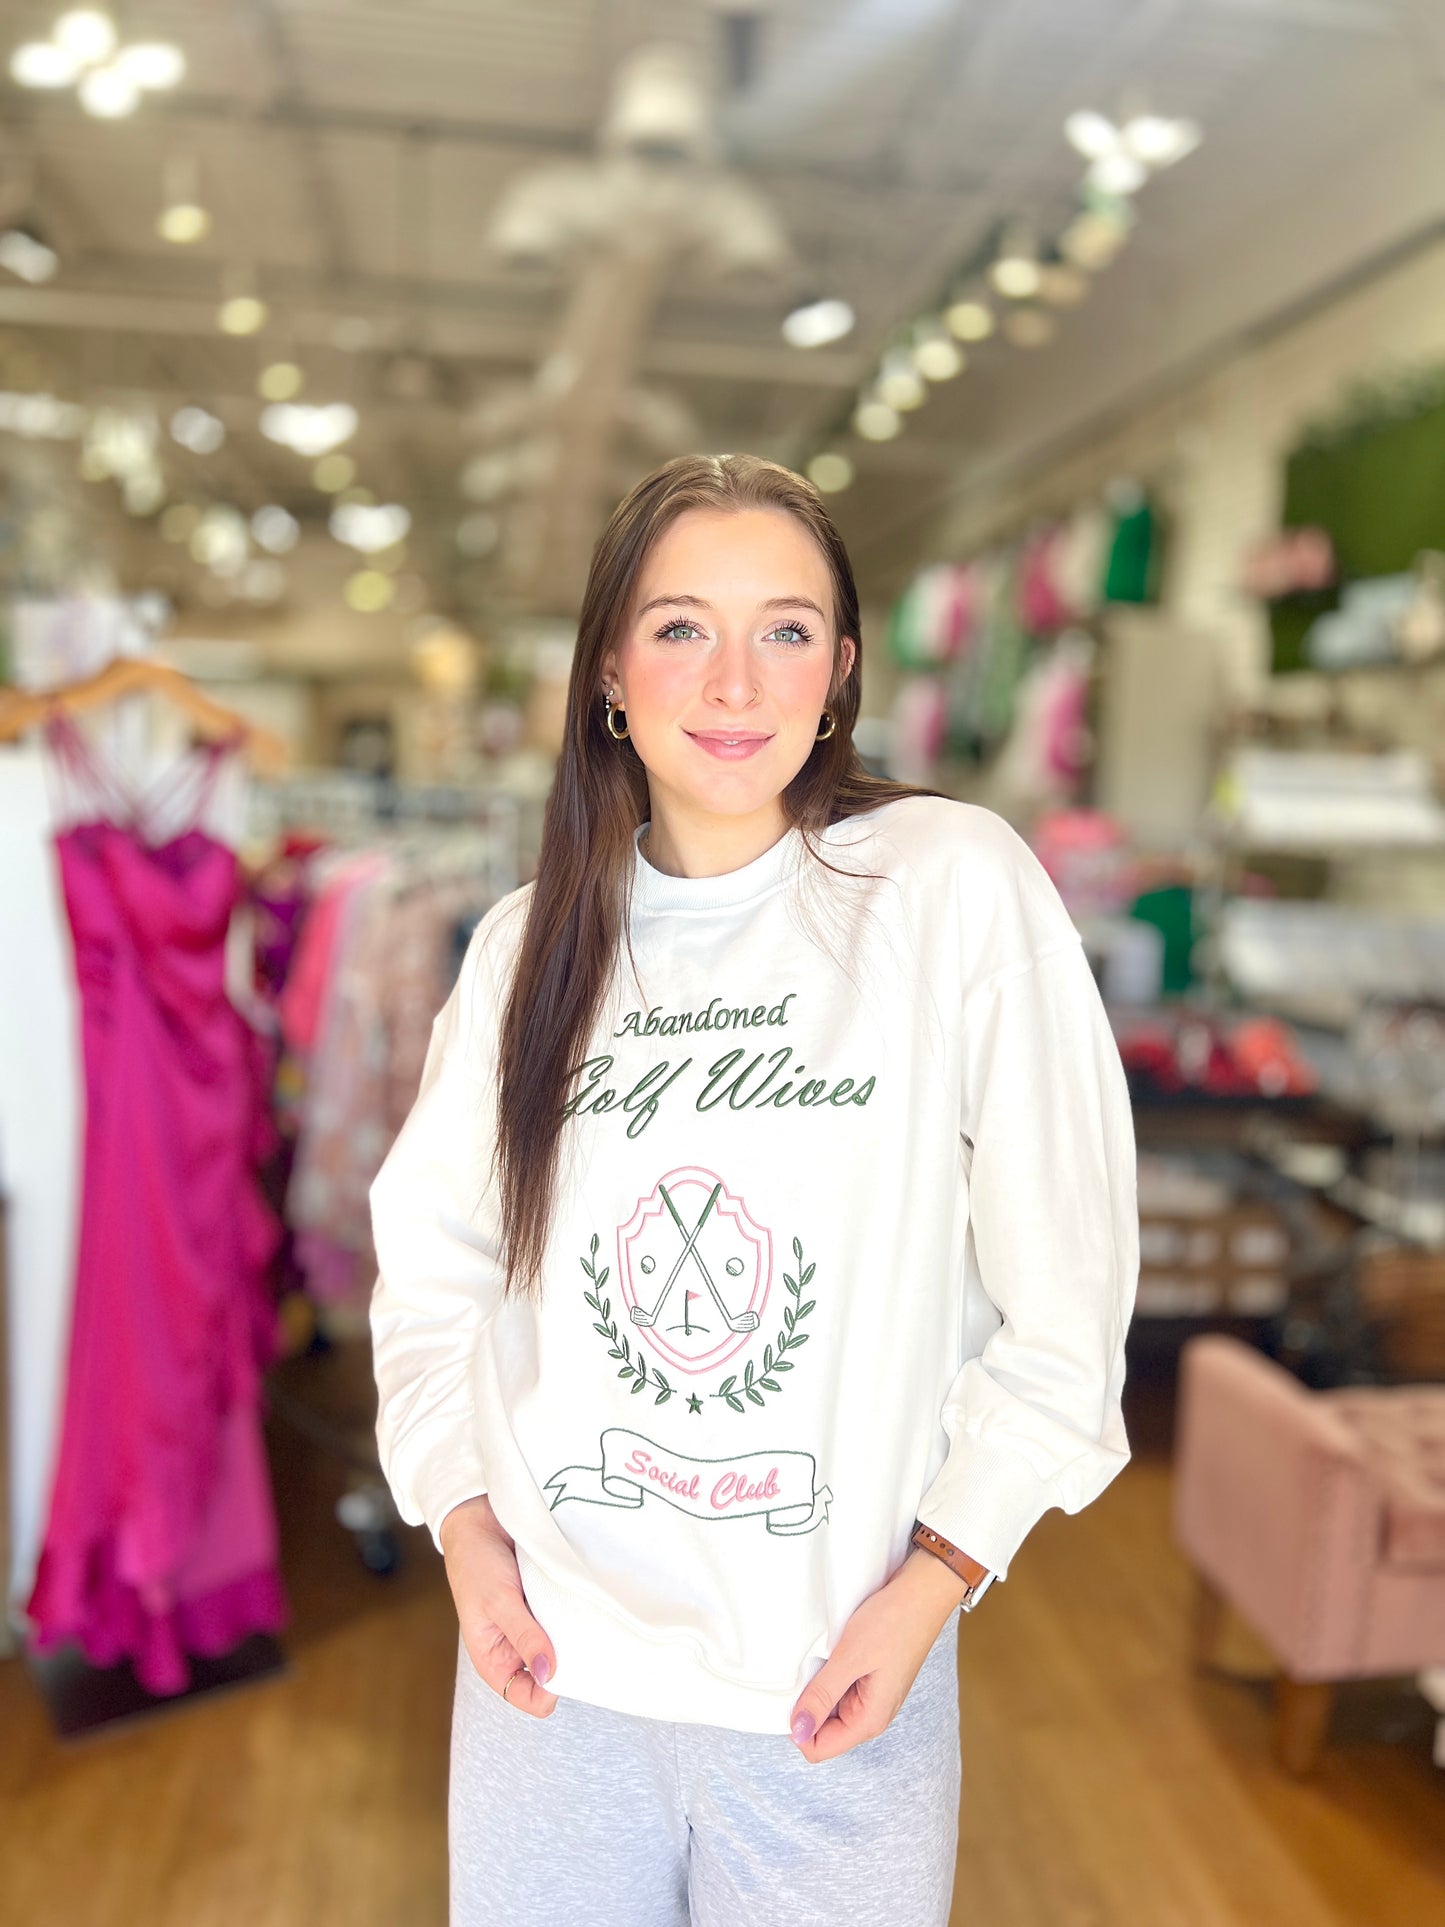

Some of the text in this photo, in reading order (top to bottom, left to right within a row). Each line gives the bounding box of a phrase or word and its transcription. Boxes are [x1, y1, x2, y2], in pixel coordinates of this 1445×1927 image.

[613, 993, 797, 1038] Abandoned
[561, 1046, 876, 1139] Golf Wives
[625, 1450, 781, 1510] Social Club
